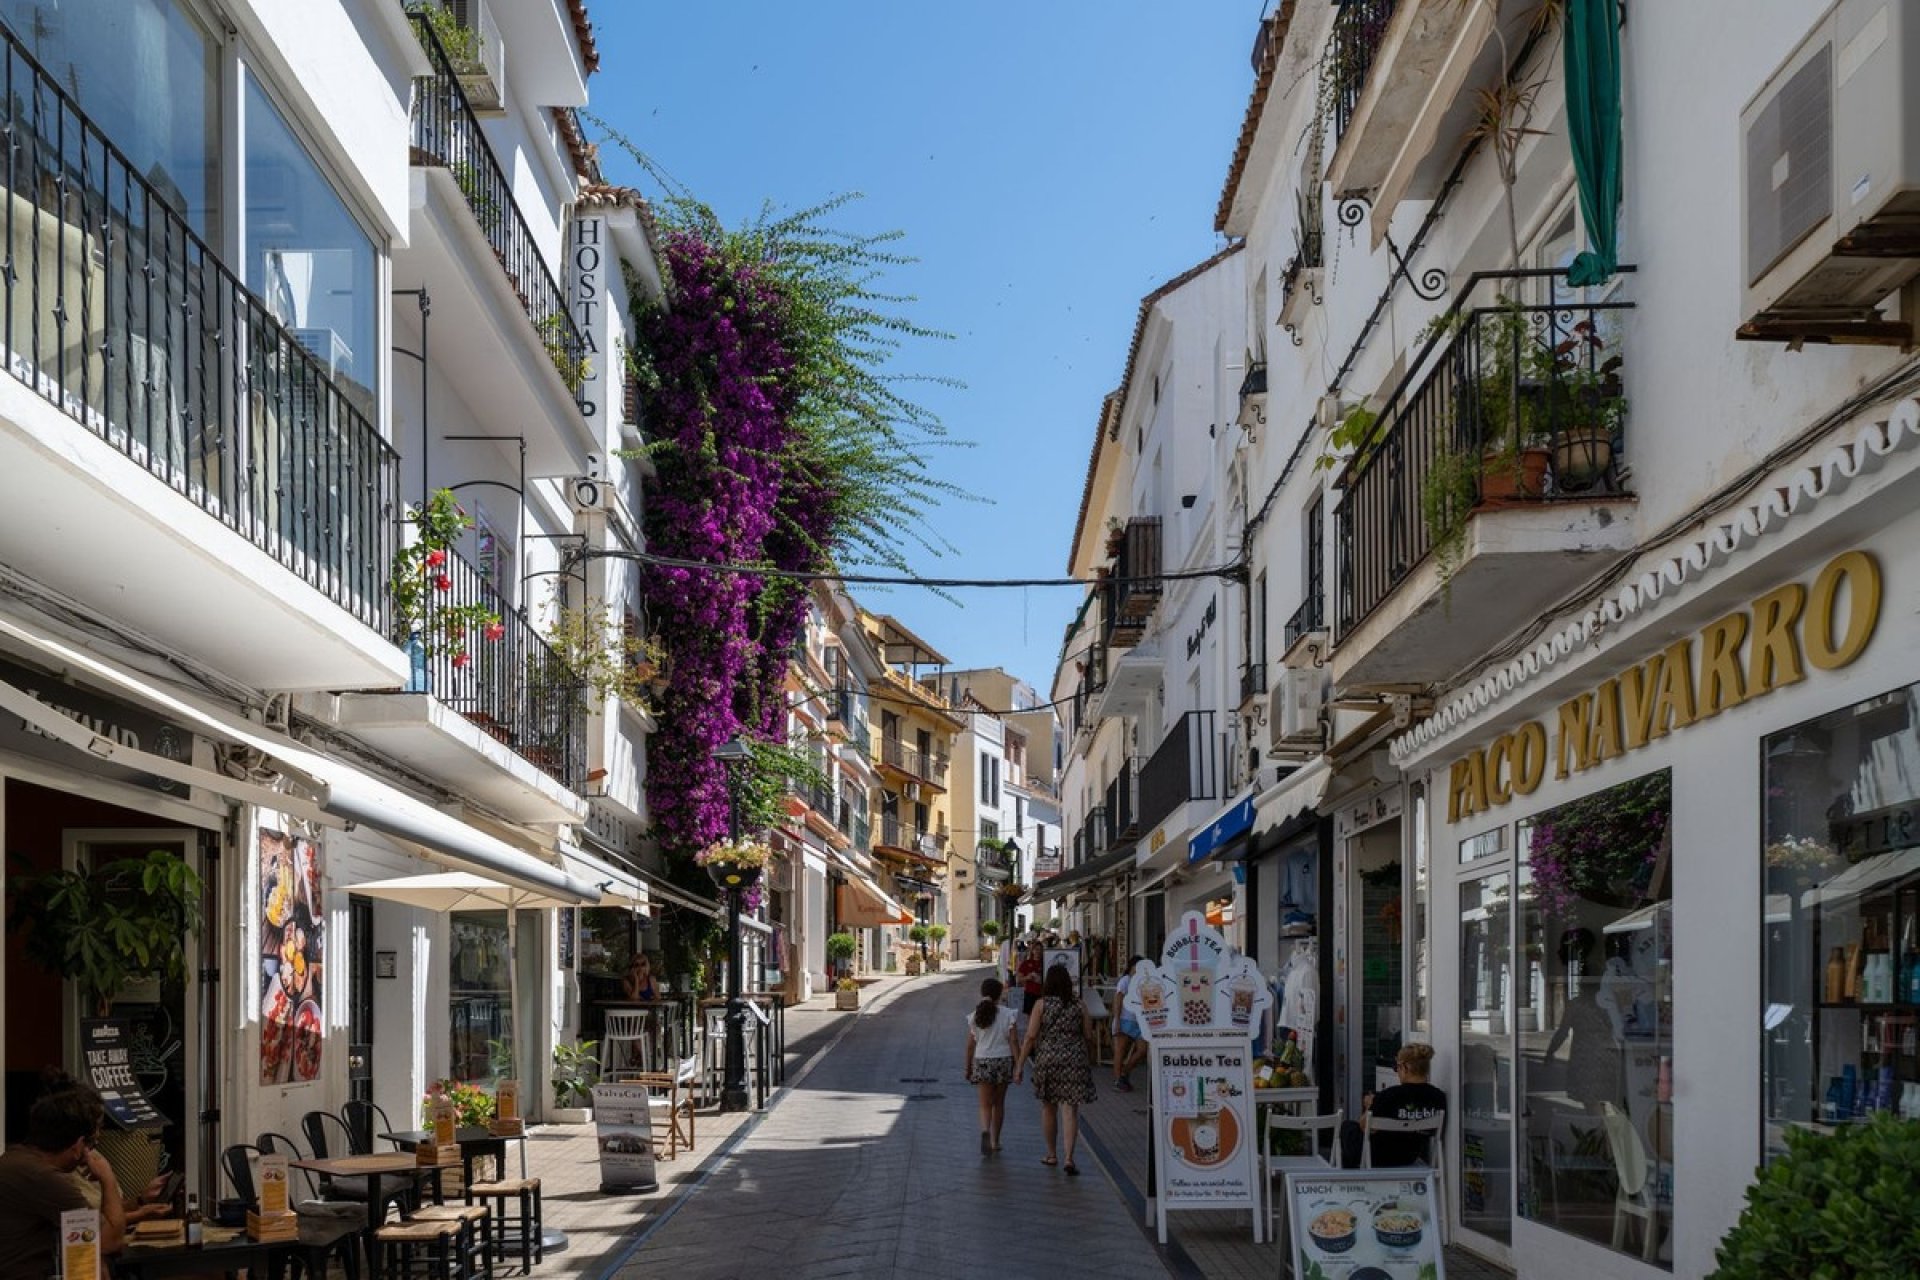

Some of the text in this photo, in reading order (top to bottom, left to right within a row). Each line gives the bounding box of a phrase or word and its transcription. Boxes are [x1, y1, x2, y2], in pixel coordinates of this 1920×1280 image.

[1448, 550, 1881, 824] PACO NAVARRO
[1166, 935, 1223, 958] BUBBLE TEA
[87, 1048, 129, 1066] TAKE AWAY
[1163, 1055, 1241, 1067] Bubble Tea
[91, 1065, 135, 1089] COFFEE
[597, 1089, 642, 1098] SalvaCar
[1398, 1107, 1440, 1119] Bubbl
[1296, 1184, 1332, 1195] LUNCH
